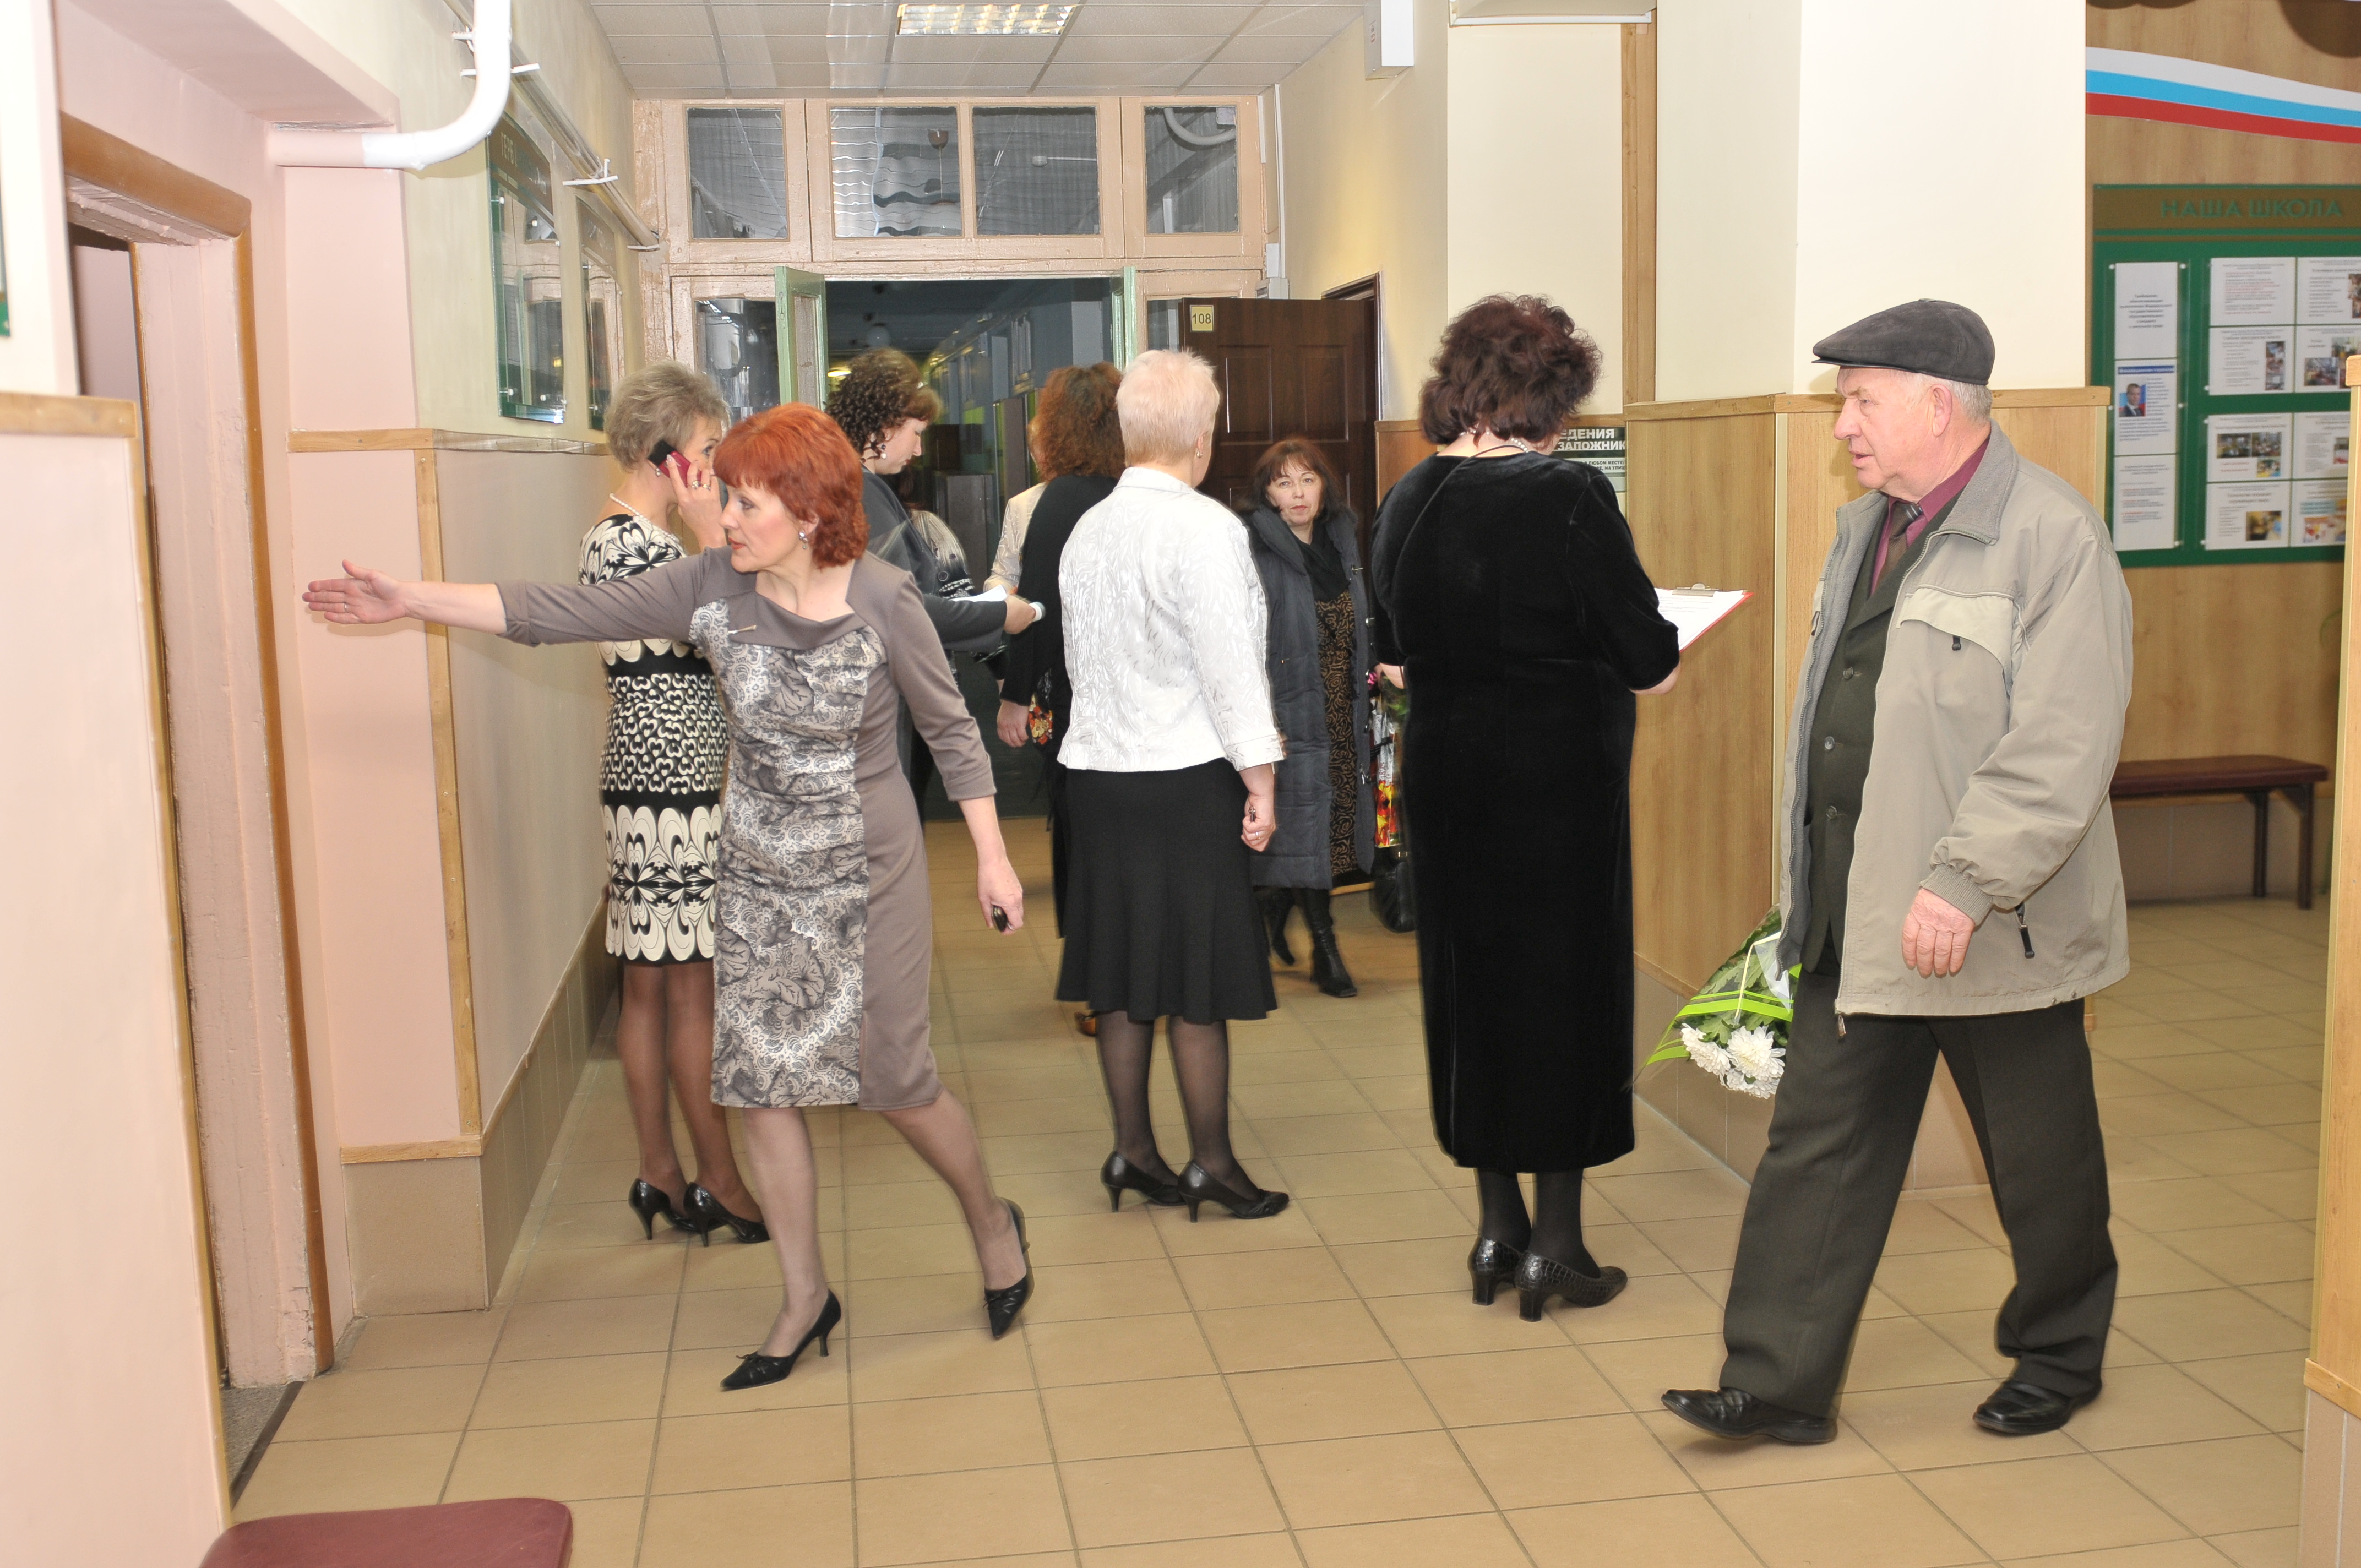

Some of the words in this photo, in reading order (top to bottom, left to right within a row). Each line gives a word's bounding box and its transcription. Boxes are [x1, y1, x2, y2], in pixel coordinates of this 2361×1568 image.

[2160, 199, 2243, 218] НАША
[2249, 199, 2342, 219] ШКОЛА
[1192, 313, 1211, 324] 108
[1557, 440, 1625, 450] ЗАЛОЖНИК
